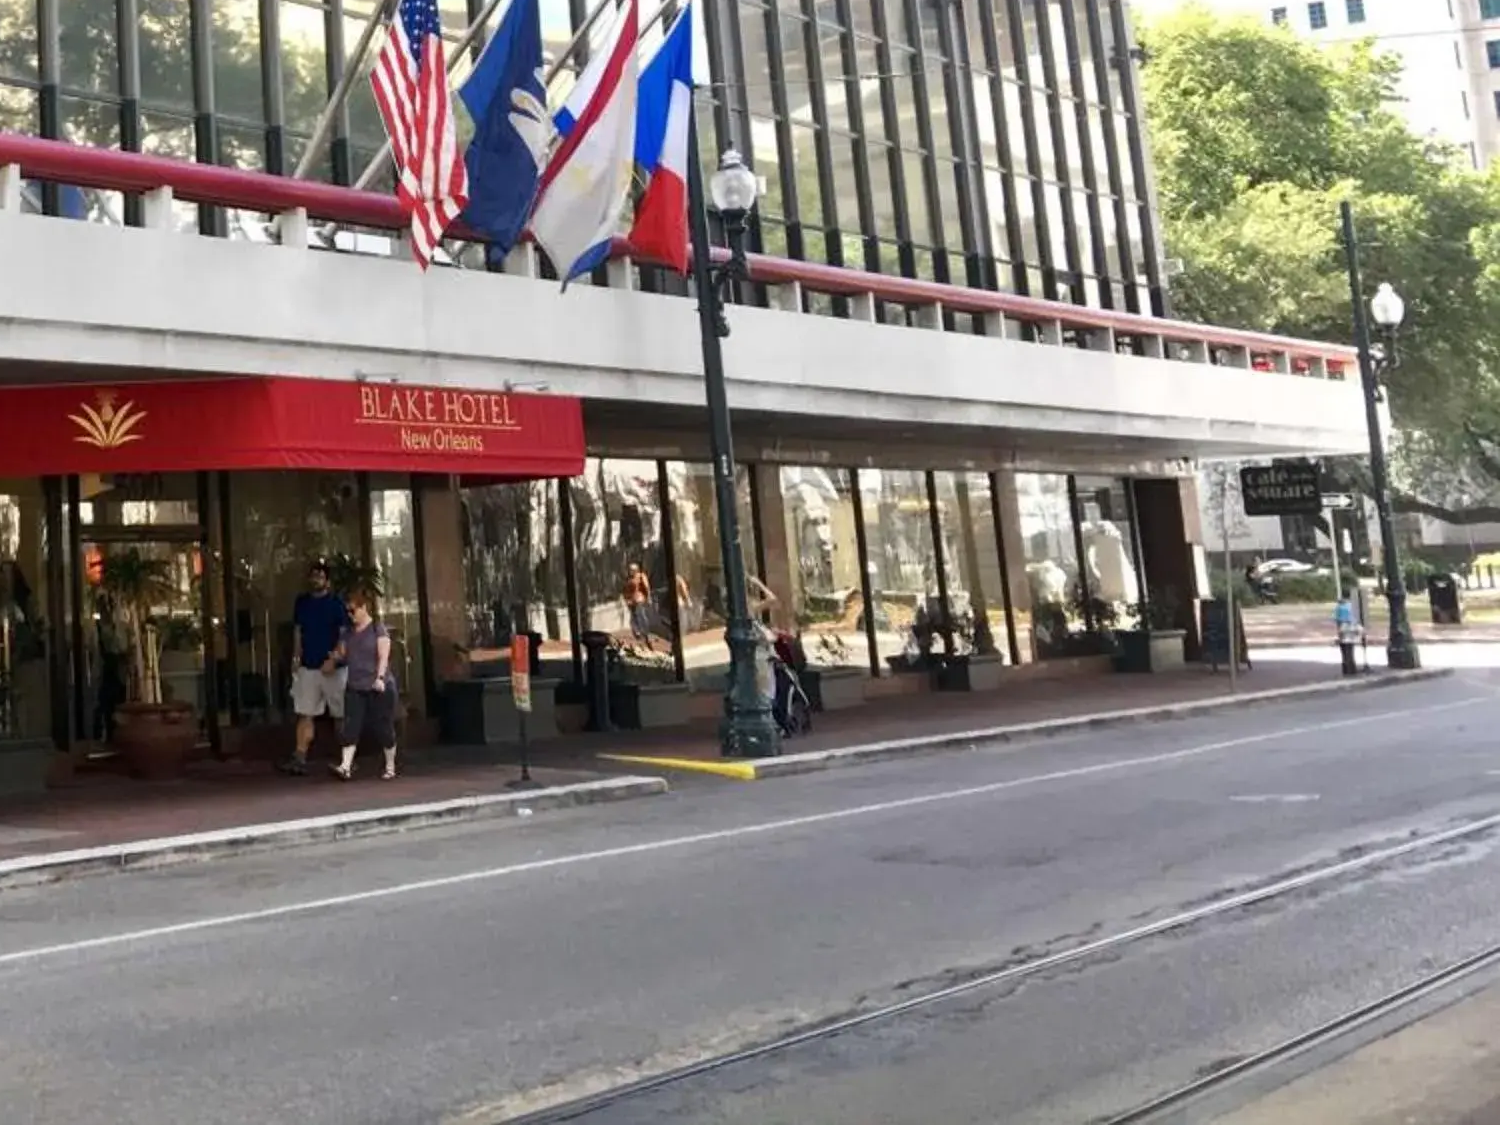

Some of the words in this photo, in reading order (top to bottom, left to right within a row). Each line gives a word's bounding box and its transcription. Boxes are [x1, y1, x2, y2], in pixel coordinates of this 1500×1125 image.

[360, 386, 437, 421] BLAKE
[441, 392, 517, 425] HOTEL
[401, 427, 431, 450] New
[433, 428, 484, 452] Orleans
